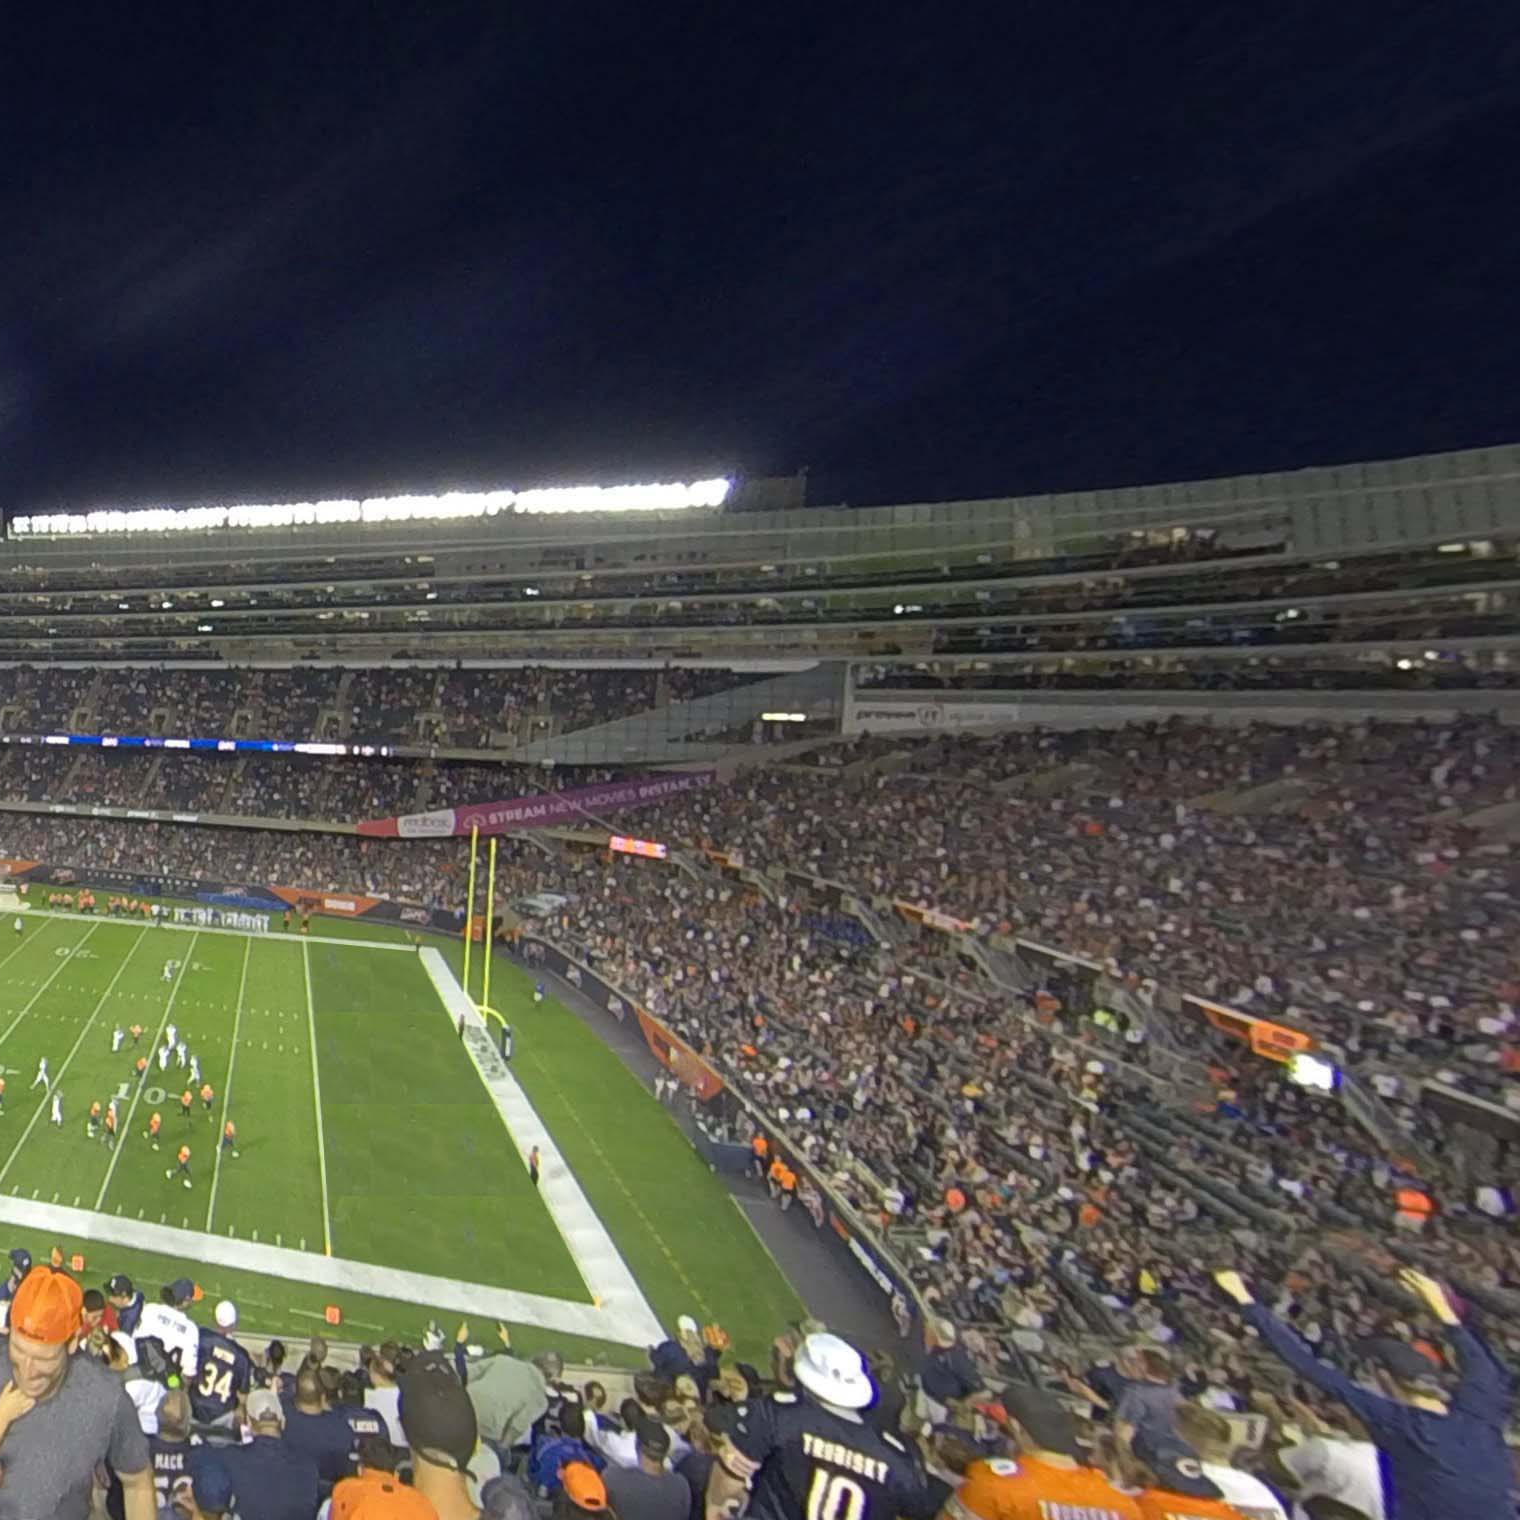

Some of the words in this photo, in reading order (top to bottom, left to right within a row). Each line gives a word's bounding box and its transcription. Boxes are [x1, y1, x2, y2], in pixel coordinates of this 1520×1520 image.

[489, 804, 547, 825] STREAM
[113, 1082, 167, 1106] 10
[198, 1362, 234, 1403] 34
[154, 1453, 185, 1470] MACK
[807, 1467, 866, 1520] 10
